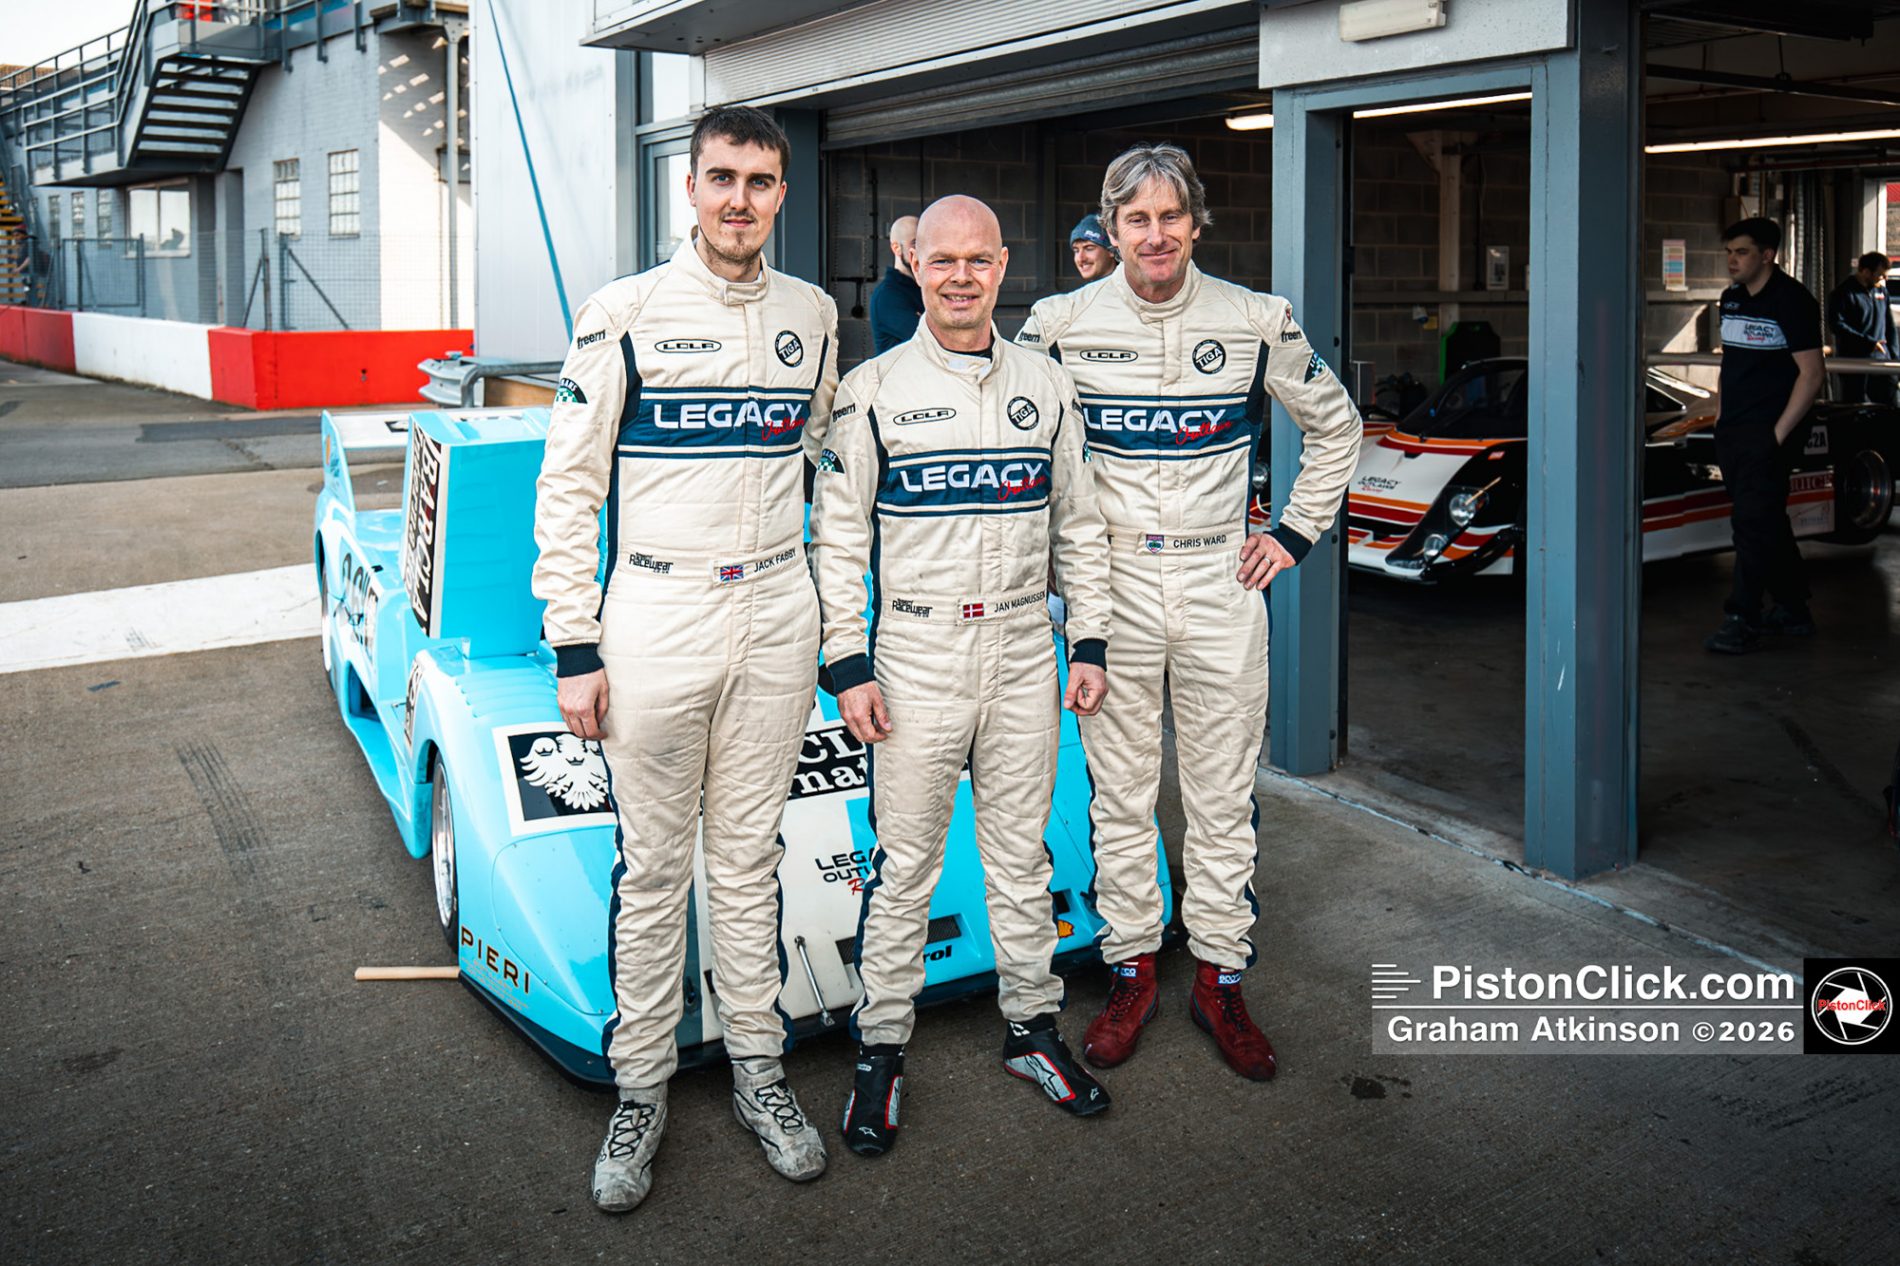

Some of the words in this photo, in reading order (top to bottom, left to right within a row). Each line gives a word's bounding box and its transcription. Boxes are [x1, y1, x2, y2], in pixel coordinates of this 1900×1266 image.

[577, 329, 606, 349] freem
[778, 340, 801, 359] TIGA
[1195, 348, 1223, 367] TIGA
[653, 401, 802, 429] LEGACY
[833, 403, 856, 422] freem
[1011, 404, 1036, 423] TIGA
[1083, 408, 1226, 433] LEGACY
[900, 463, 1043, 492] LEGACY
[412, 451, 438, 634] BARCLA
[1173, 538, 1201, 549] CHRIS
[1203, 534, 1227, 546] WARD
[753, 557, 773, 573] JACK
[994, 601, 1010, 613] JAN
[461, 926, 529, 994] PIERI
